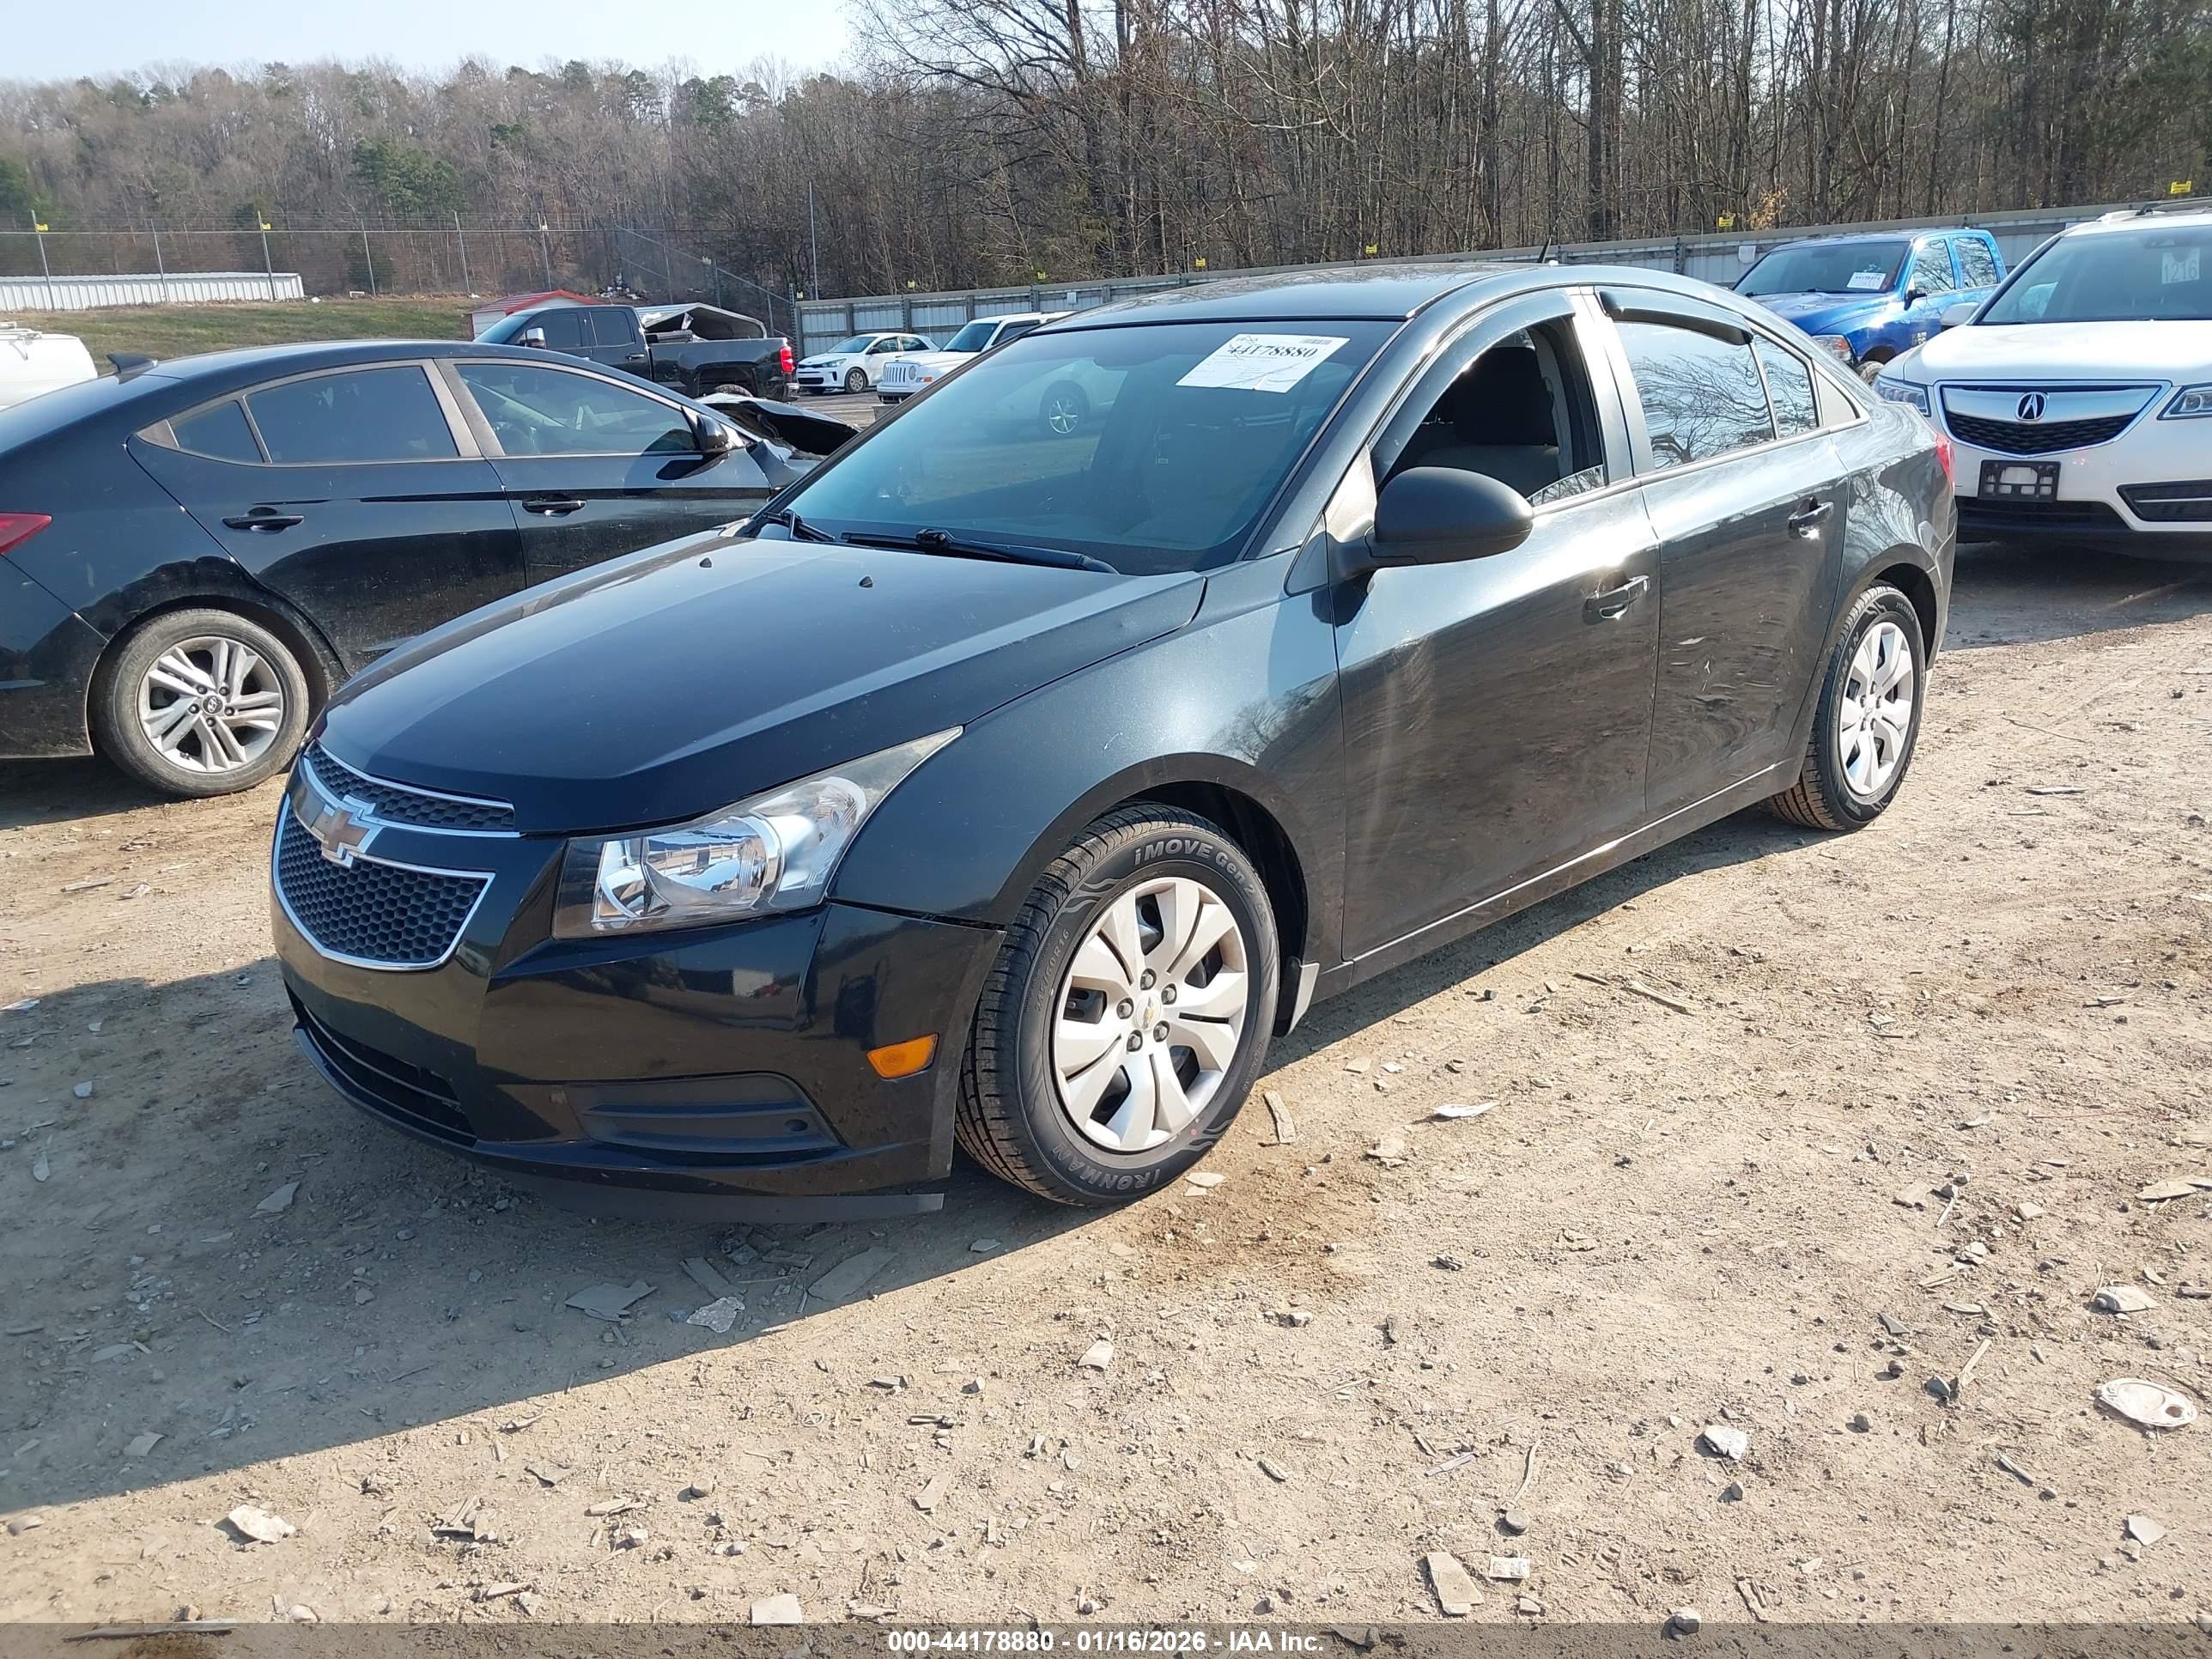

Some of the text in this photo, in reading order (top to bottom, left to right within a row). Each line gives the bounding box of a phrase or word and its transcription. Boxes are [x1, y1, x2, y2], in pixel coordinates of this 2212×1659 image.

[2163, 259, 2197, 283] 1216
[1227, 344, 1318, 358] 44178880
[1215, 851, 1246, 885] Gen
[1243, 884, 1256, 895] 2
[1052, 1142, 1161, 1190] IRONMAN
